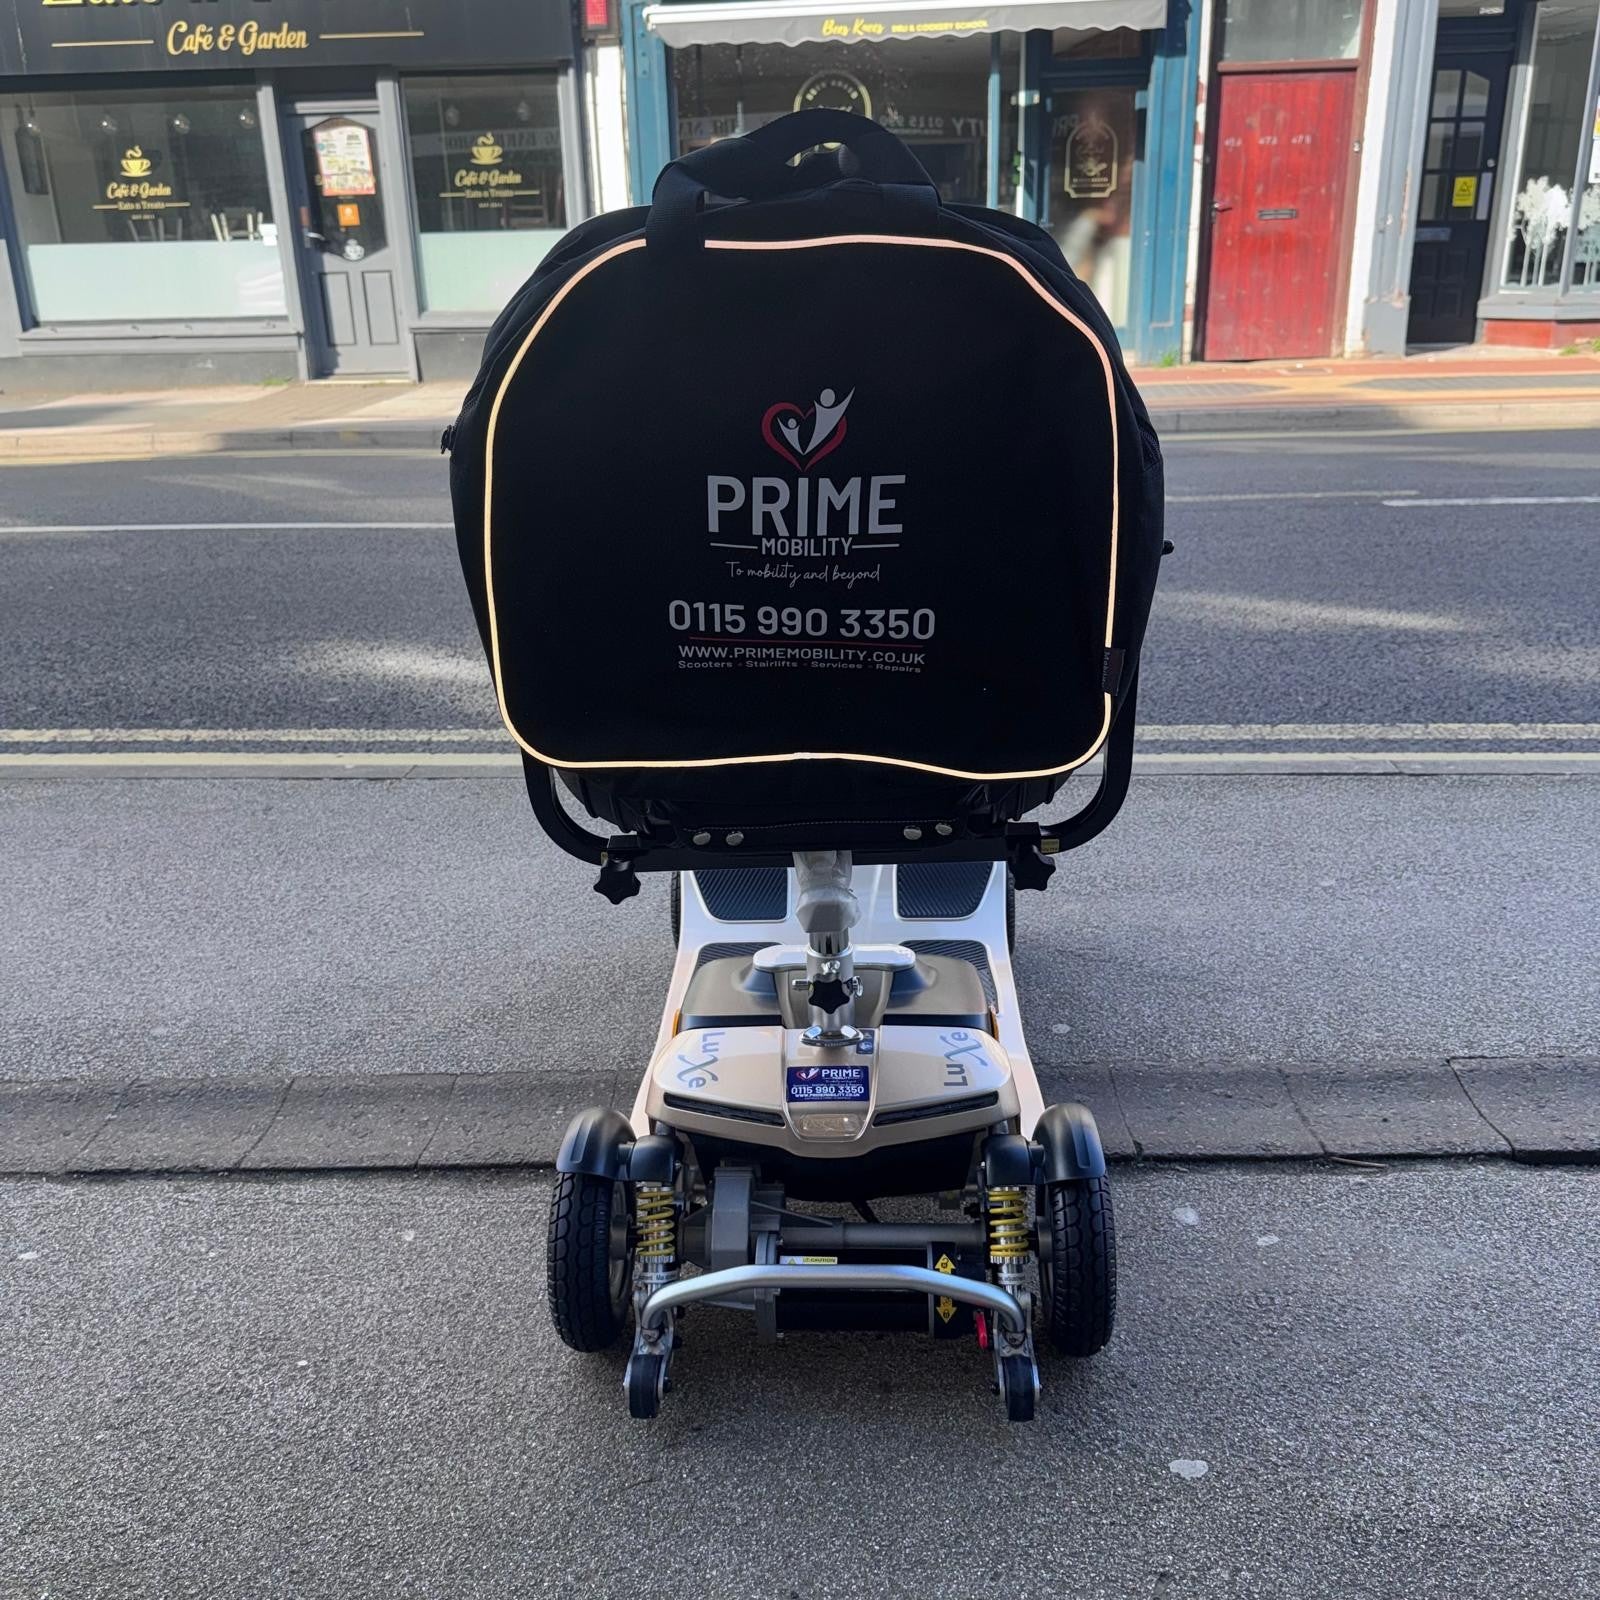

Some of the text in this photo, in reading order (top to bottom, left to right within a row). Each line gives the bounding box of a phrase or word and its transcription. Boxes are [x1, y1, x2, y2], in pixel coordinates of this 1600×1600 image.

[167, 20, 309, 56] Café & Garden
[479, 171, 487, 185] &
[488, 169, 522, 187] Garden
[130, 184, 139, 197] &
[140, 181, 172, 199] Garden
[707, 474, 906, 537] PRIME
[761, 537, 853, 557] MOBILITY
[725, 561, 881, 589] To mobility and beyond
[668, 599, 936, 640] 0115 990 3350
[678, 645, 926, 665] WWW.PRIMEMOBILITY.CO.UK
[678, 660, 921, 673] Scooters Stairlifts Services Repairs
[821, 1068, 861, 1078] PRIME
[791, 1086, 865, 1095] 0115 990 3350
